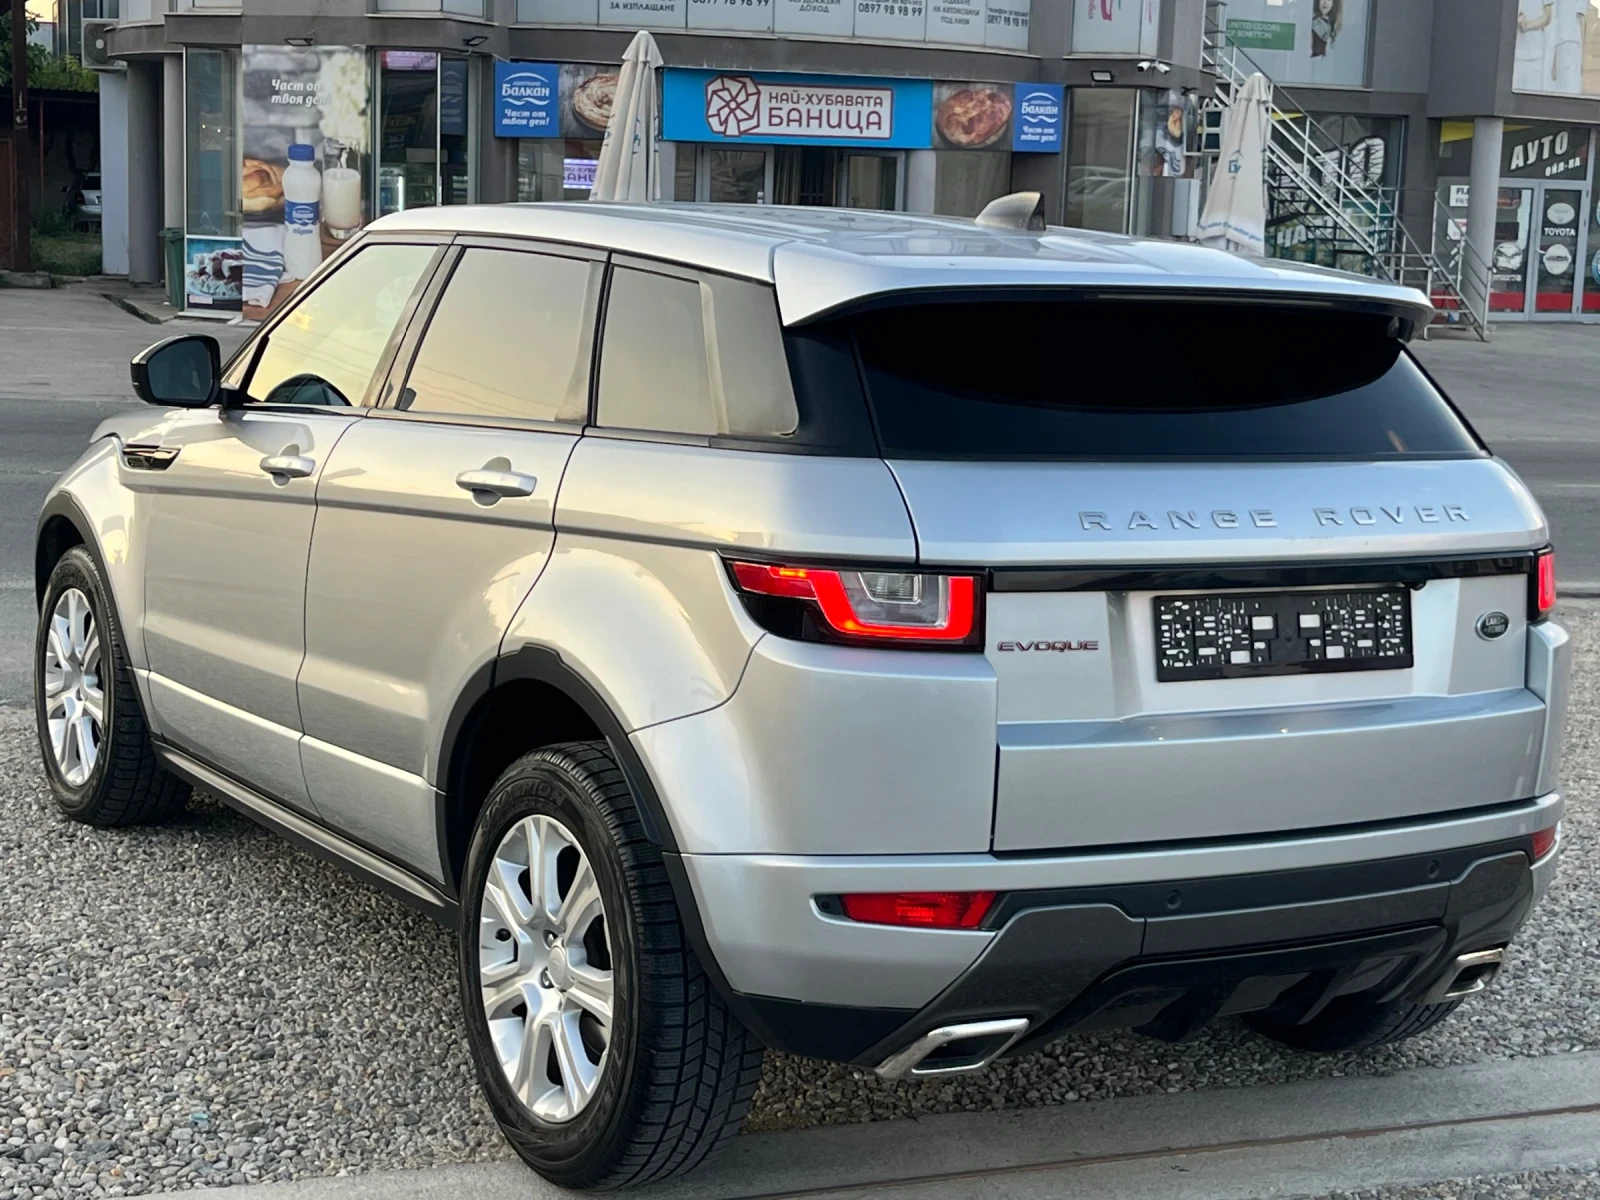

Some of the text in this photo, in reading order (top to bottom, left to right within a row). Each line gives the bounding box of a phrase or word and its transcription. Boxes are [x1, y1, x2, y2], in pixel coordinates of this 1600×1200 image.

[609, 2, 675, 12] ЗА ИЗПЛАЩАНЕ
[799, 4, 830, 13] ДОХОД
[858, 2, 881, 14] 0897
[884, 4, 895, 15] 98
[898, 5, 909, 16] 98
[911, 6, 922, 17] 99
[271, 78, 304, 91] Част
[501, 83, 550, 97] Балкан
[270, 92, 304, 105] твоя
[768, 90, 883, 108] НАЙ-ХУБАВАТА
[504, 108, 530, 118] Част
[1021, 102, 1059, 115] Балкан
[502, 117, 550, 128] твоя ден!
[768, 106, 882, 135] БАНИЦА
[1509, 131, 1569, 171] АУТО
[1543, 227, 1576, 236] TOYOTA
[1078, 503, 1471, 531] RANGE ROVER
[997, 640, 1099, 653] EVOQUE
